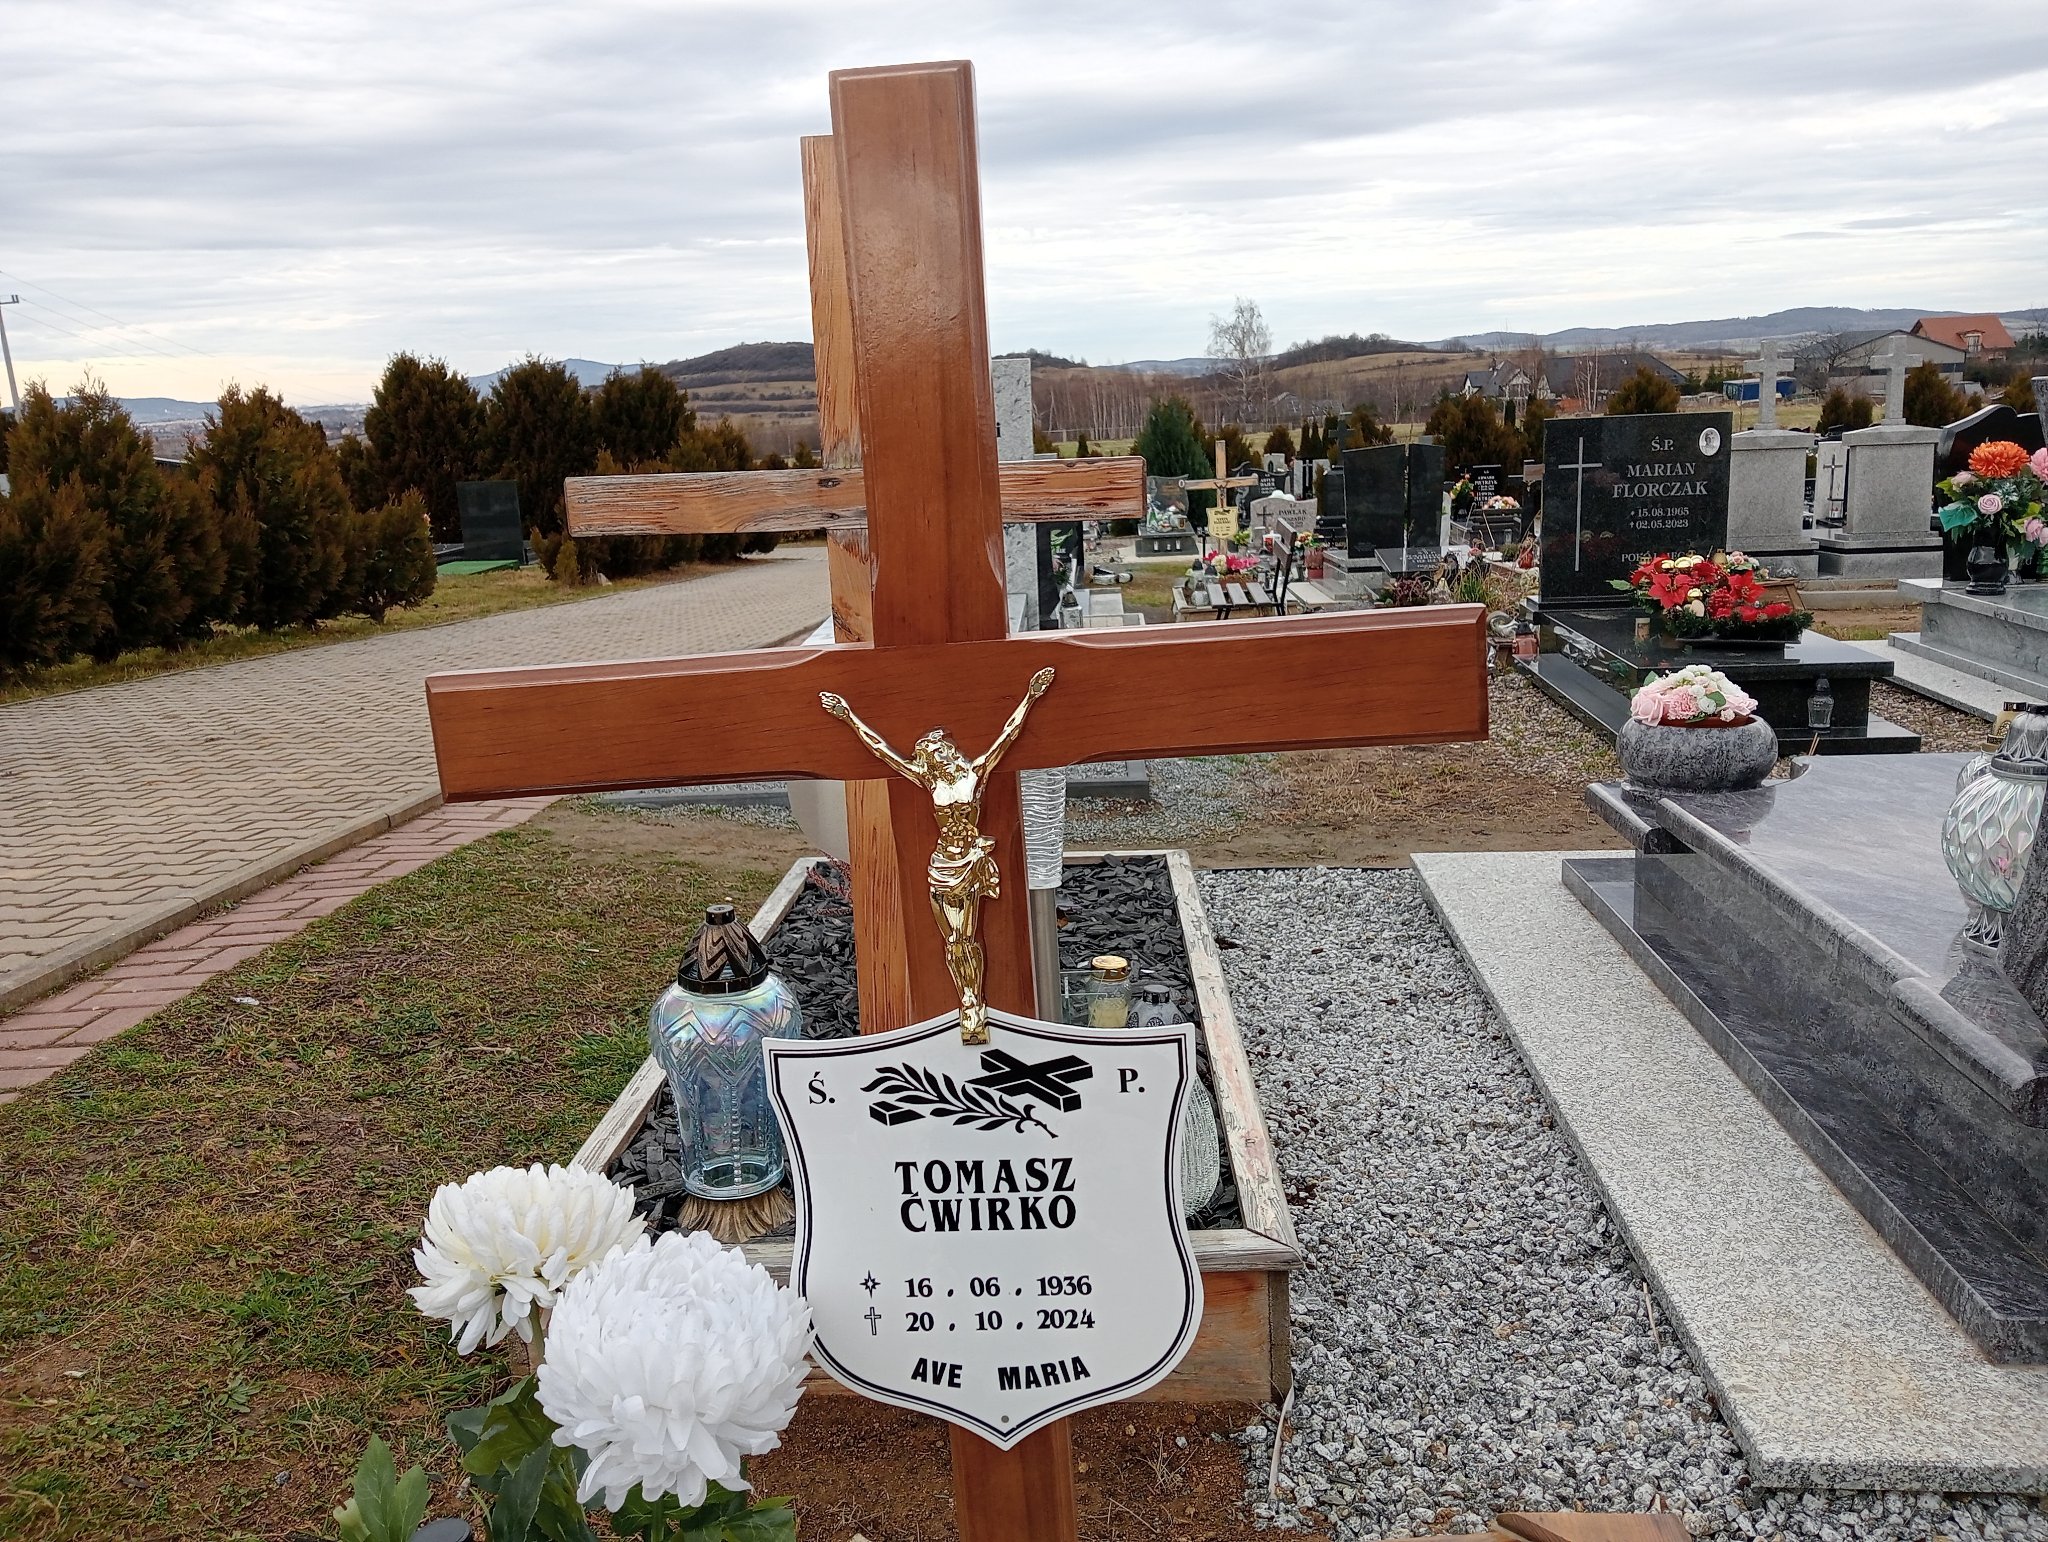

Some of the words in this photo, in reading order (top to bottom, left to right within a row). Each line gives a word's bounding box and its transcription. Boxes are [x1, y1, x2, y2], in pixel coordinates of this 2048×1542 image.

[1627, 462, 1696, 478] MARIAN
[1612, 481, 1708, 498] FLORCZAK
[1636, 519, 1689, 529] 02.05.2023
[1637, 507, 1689, 517] 15.08.1965
[808, 1071, 836, 1104] Ś.
[1117, 1068, 1146, 1093] P.
[895, 1158, 1076, 1195] TOMASZ
[900, 1191, 1076, 1232] ĆWIRKO
[910, 1357, 963, 1389] AVE
[997, 1356, 1091, 1391] MARIA
